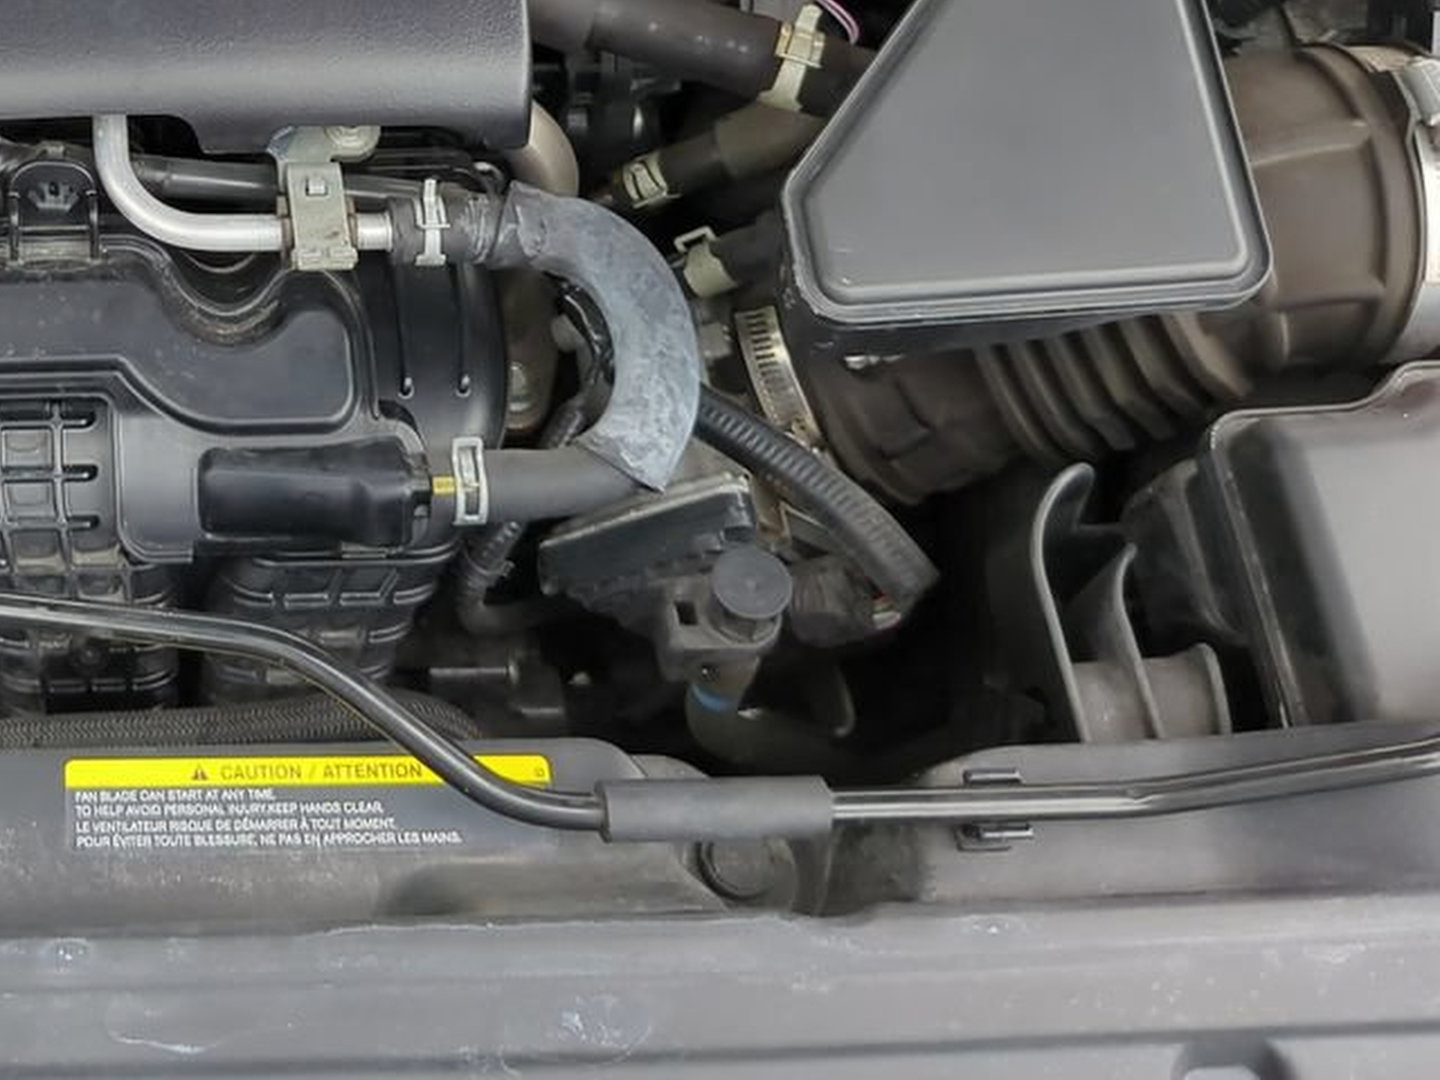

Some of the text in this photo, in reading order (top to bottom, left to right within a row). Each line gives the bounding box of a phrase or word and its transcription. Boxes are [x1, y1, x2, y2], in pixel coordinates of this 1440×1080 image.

[220, 764, 302, 781] CAUTION
[323, 762, 423, 779] ATTENTION
[75, 790, 97, 803] FAN
[100, 790, 138, 803] BLADE
[140, 789, 164, 802] CAN
[167, 789, 202, 801] START
[205, 789, 219, 801] AT
[221, 788, 245, 801] ANY
[75, 804, 91, 817] TO
[94, 804, 124, 816] HELP
[126, 804, 161, 816] AVOID
[164, 803, 225, 816] PERSONAL
[300, 802, 341, 814] HANDS
[76, 821, 90, 833] LE
[92, 820, 166, 833] VENTILATEUR
[168, 819, 212, 833] RISQUE
[215, 819, 231, 831] DE
[233, 817, 298, 831] DÉMARRER
[312, 818, 341, 829] TOUT
[76, 836, 110, 848] POUR
[113, 833, 152, 848] ÉVITER
[154, 836, 191, 848] TOUTE
[260, 834, 276, 845] NE
[278, 833, 301, 845] PAS
[304, 833, 320, 846] EN
[322, 833, 397, 845] APPROCHER
[398, 832, 420, 844] LES
